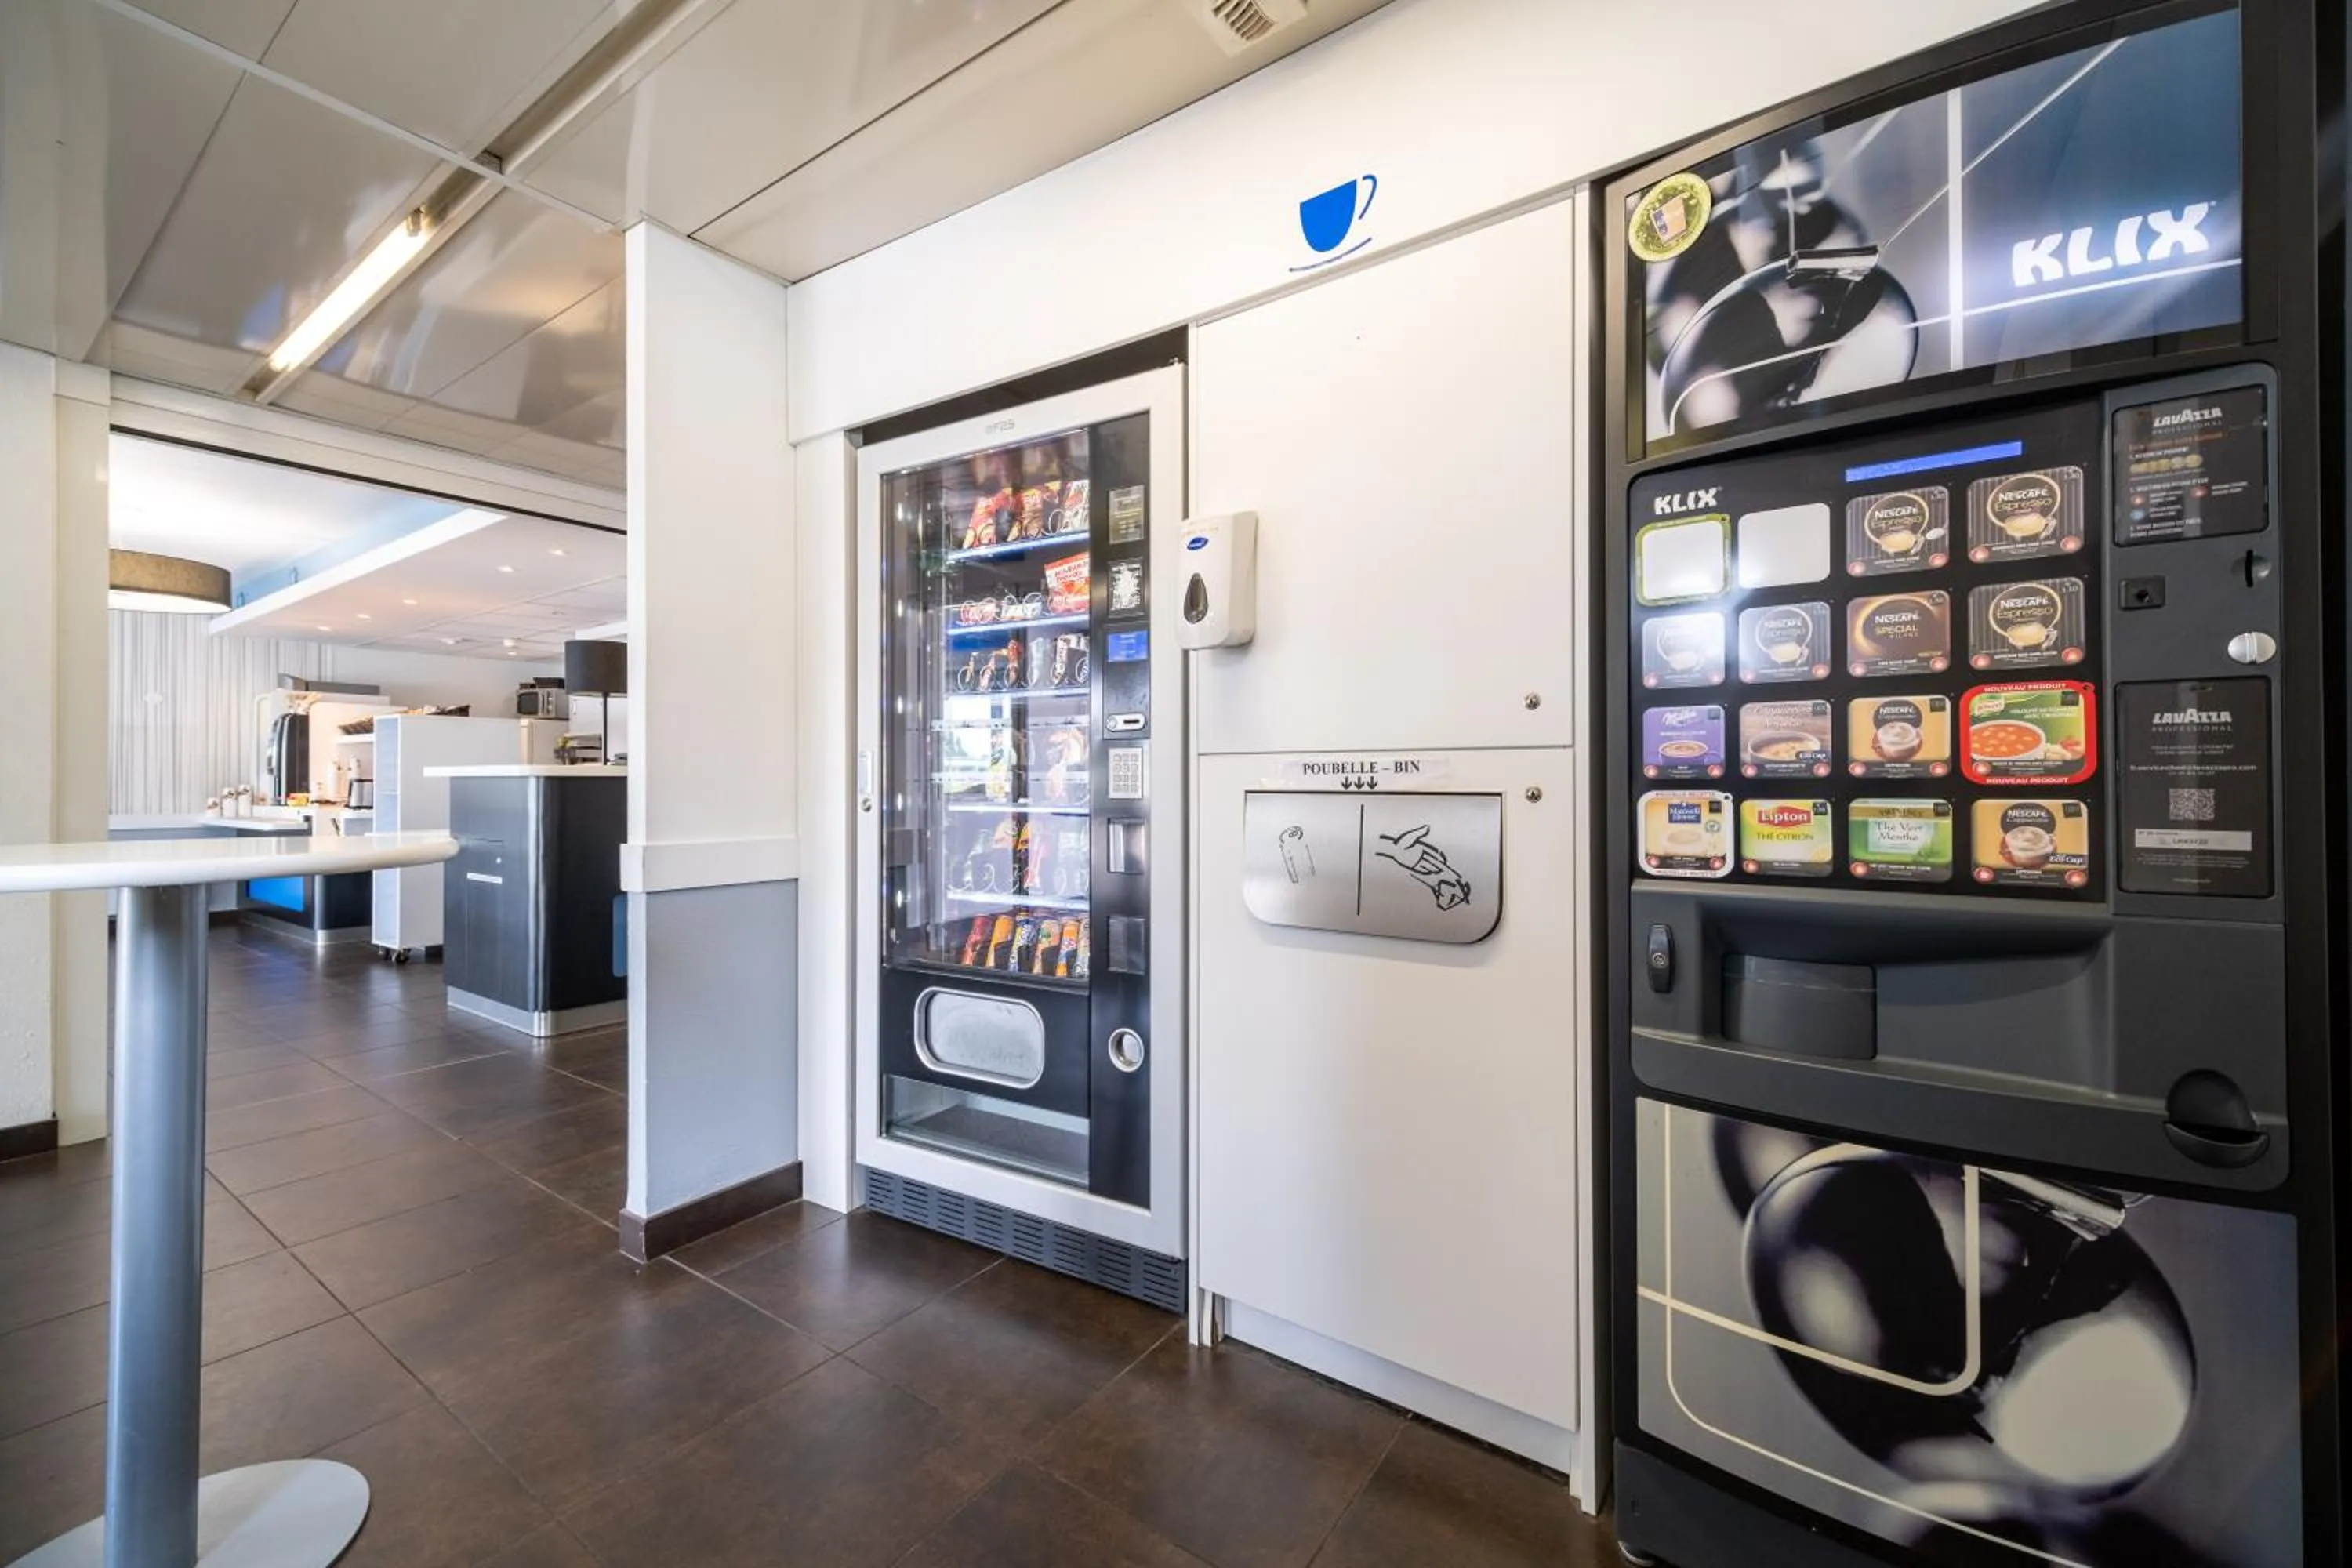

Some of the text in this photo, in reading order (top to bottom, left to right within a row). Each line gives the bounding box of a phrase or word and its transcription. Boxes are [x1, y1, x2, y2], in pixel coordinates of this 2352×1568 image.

[2012, 202, 2209, 288] KLIX
[2154, 407, 2222, 427] LAVAZZA
[1654, 487, 1718, 515] KLIX
[1984, 684, 2026, 692] NOUVEAU
[2153, 708, 2233, 724] LAVAZZA
[1303, 761, 1378, 775] POUBELLE
[1394, 760, 1420, 773] BIN
[1762, 808, 1807, 825] Lipton
